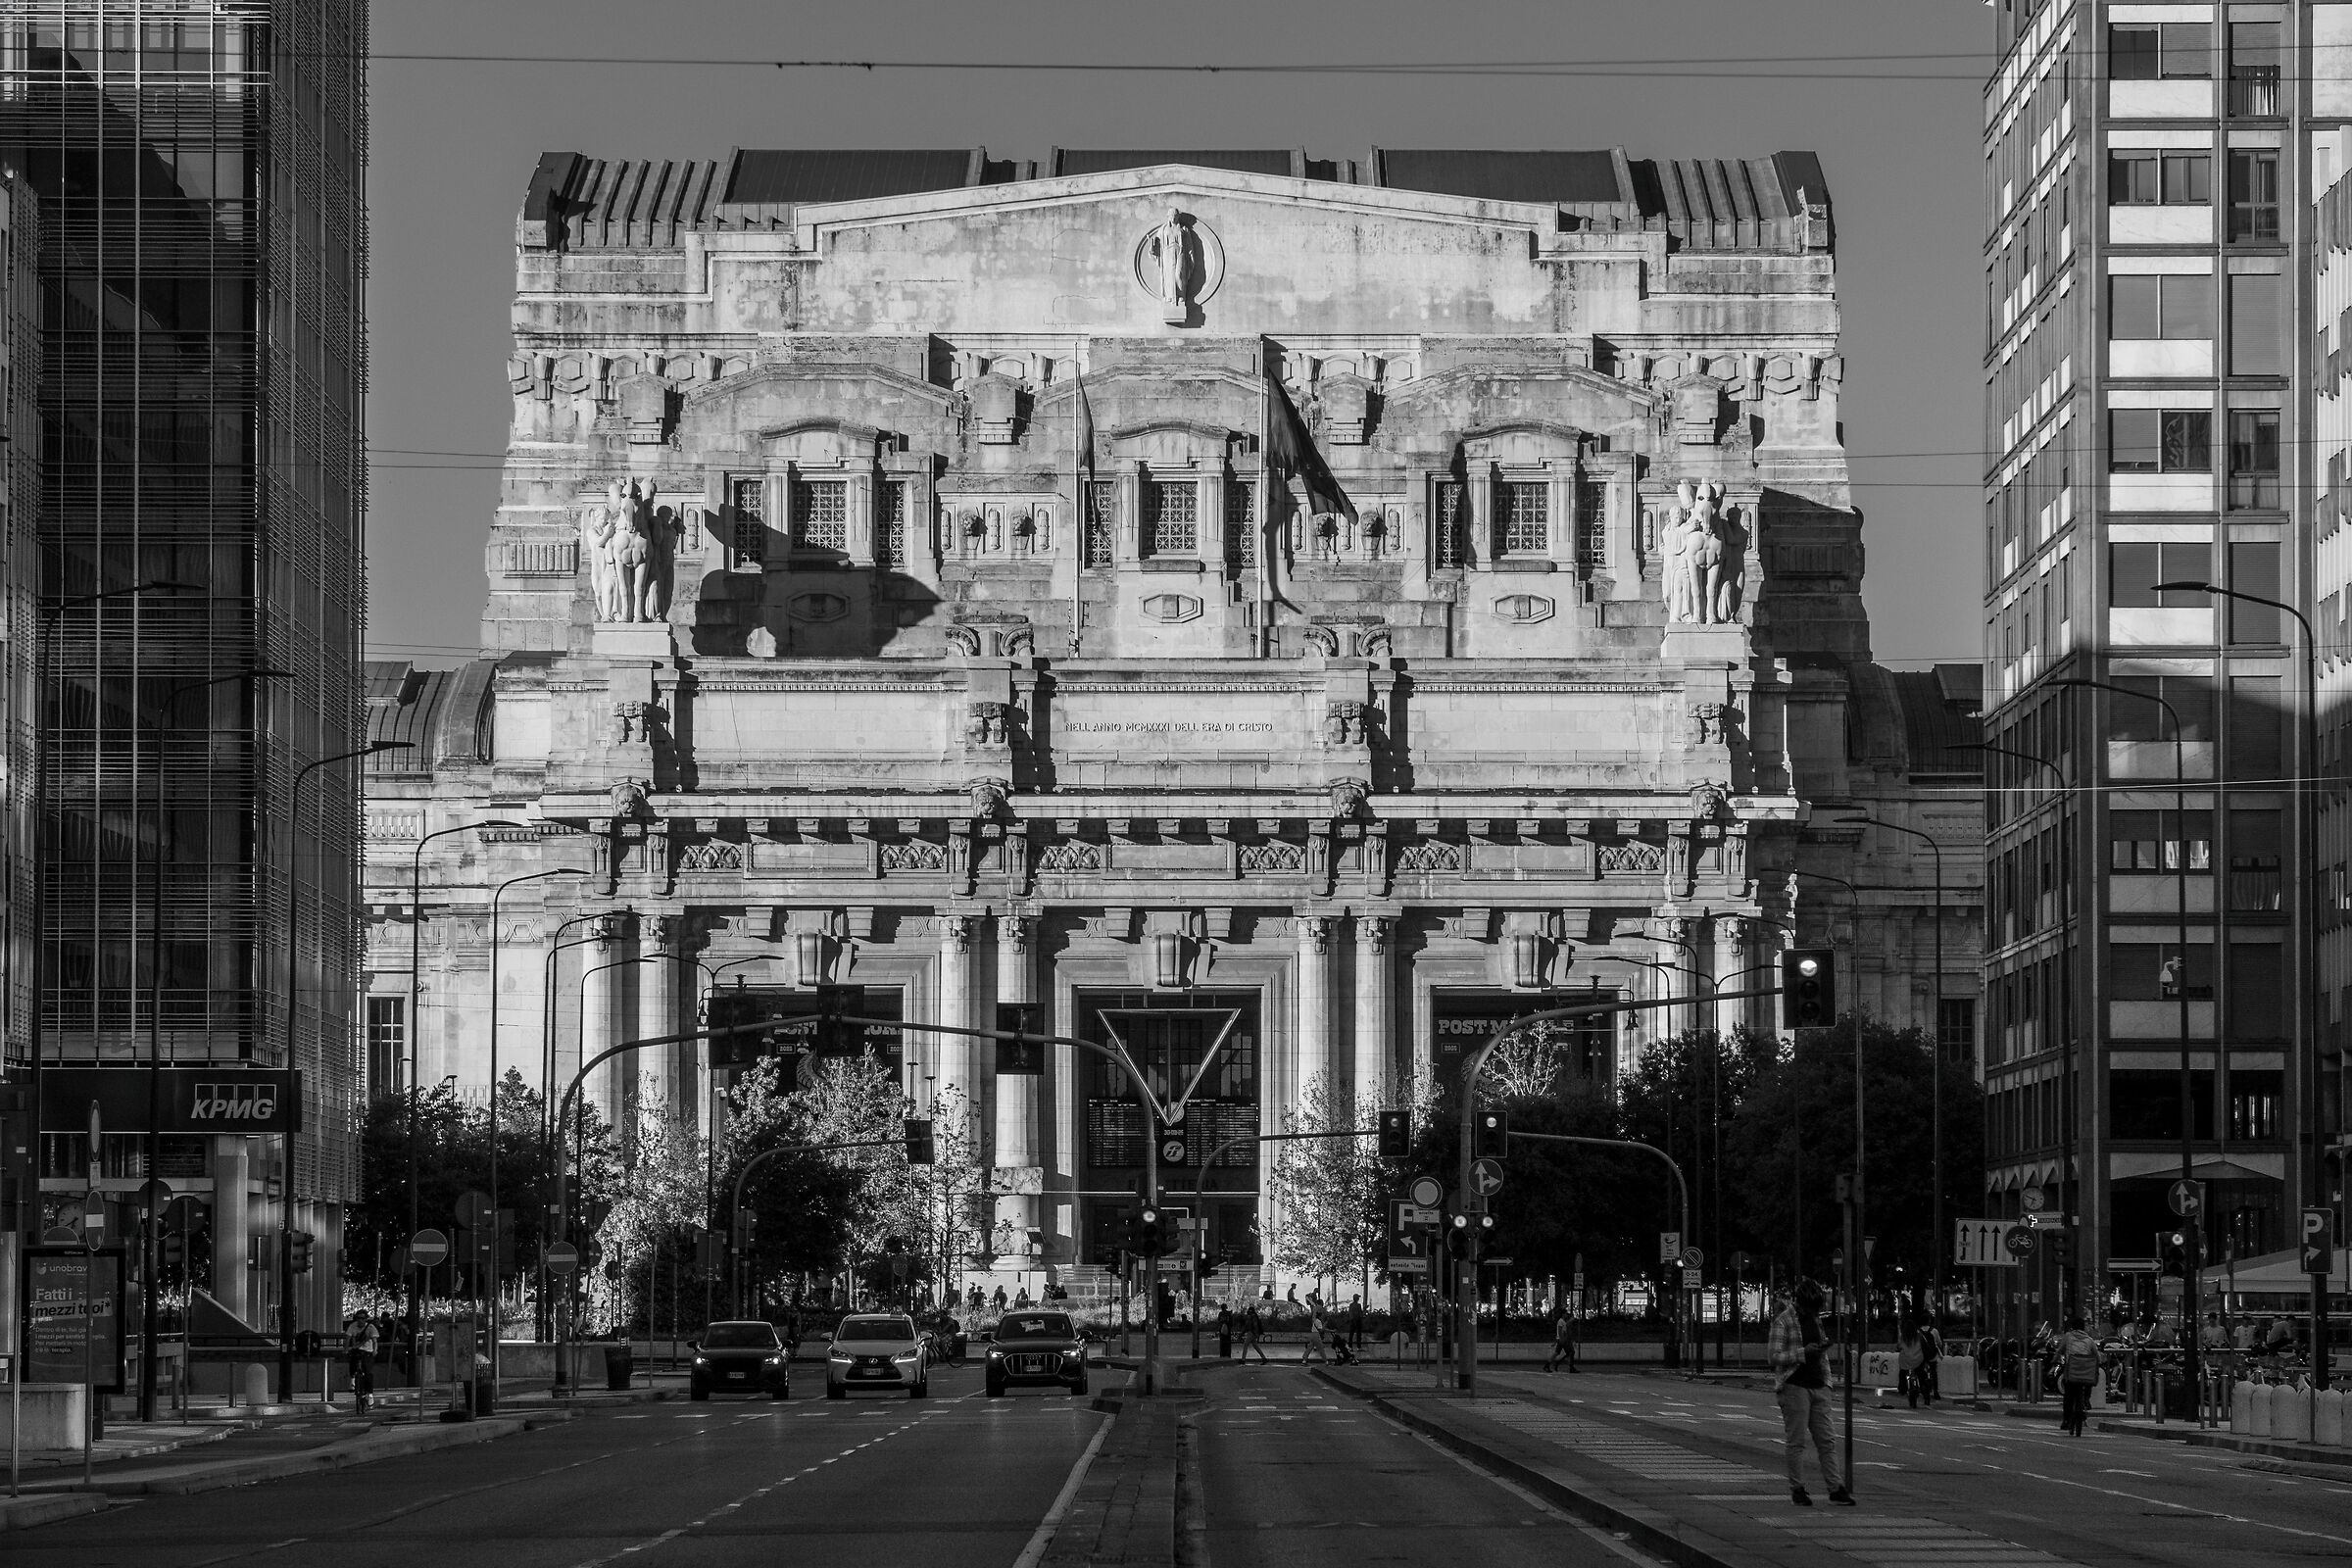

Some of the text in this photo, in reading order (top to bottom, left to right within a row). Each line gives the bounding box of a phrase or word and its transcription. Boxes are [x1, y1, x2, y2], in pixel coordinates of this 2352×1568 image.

[1065, 722, 1273, 732] NELL ANNO MCMXXXI DELL ERA DI CRISTO
[1438, 1019, 1488, 1035] POST
[190, 1098, 273, 1120] KPMG
[2302, 1213, 2324, 1244] P
[35, 1289, 73, 1300] Fatti i
[35, 1303, 75, 1317] mezzi
